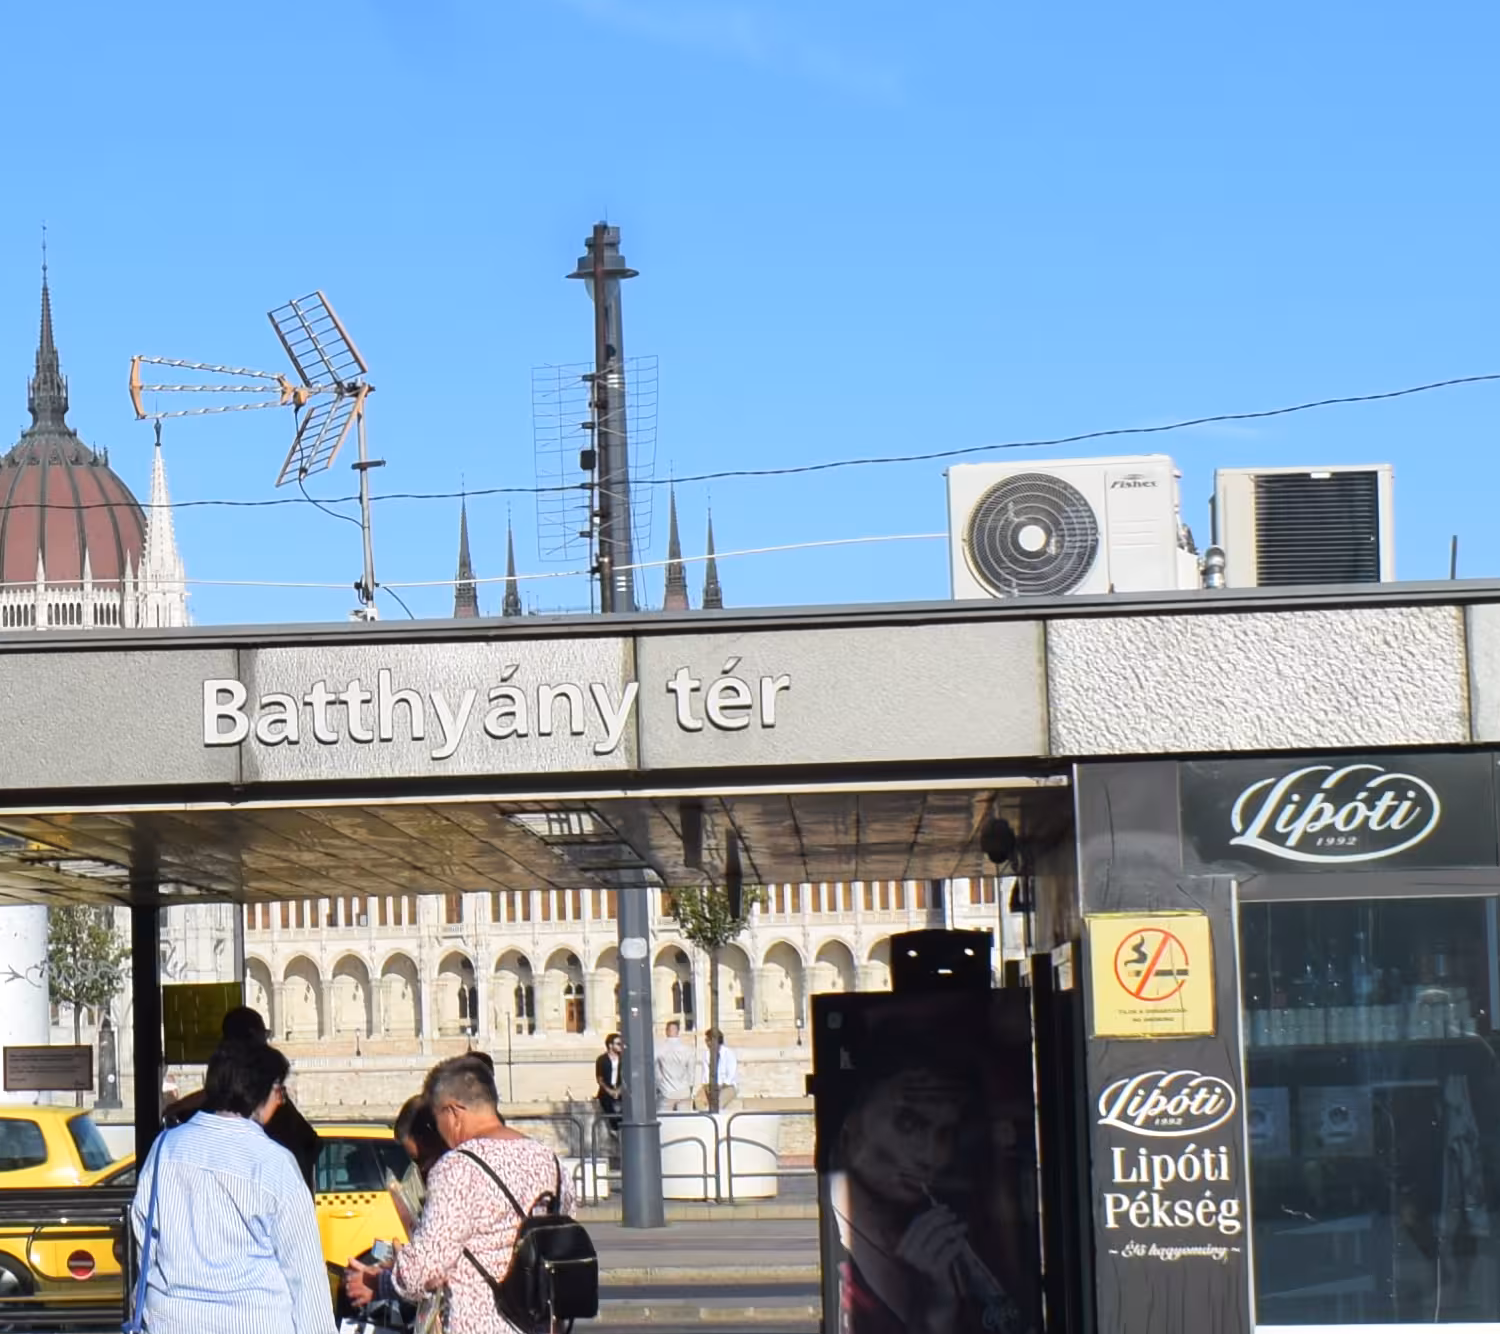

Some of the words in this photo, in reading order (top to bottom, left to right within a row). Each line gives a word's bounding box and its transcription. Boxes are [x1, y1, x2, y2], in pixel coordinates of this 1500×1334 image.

[202, 664, 639, 759] Batthyány
[667, 656, 791, 732] tér
[1230, 764, 1432, 854] Lipóti
[1316, 835, 1358, 847] 1992
[1097, 1070, 1231, 1131] Lipóti
[1111, 1142, 1230, 1190] Lipóti
[1103, 1189, 1242, 1235] Pékség
